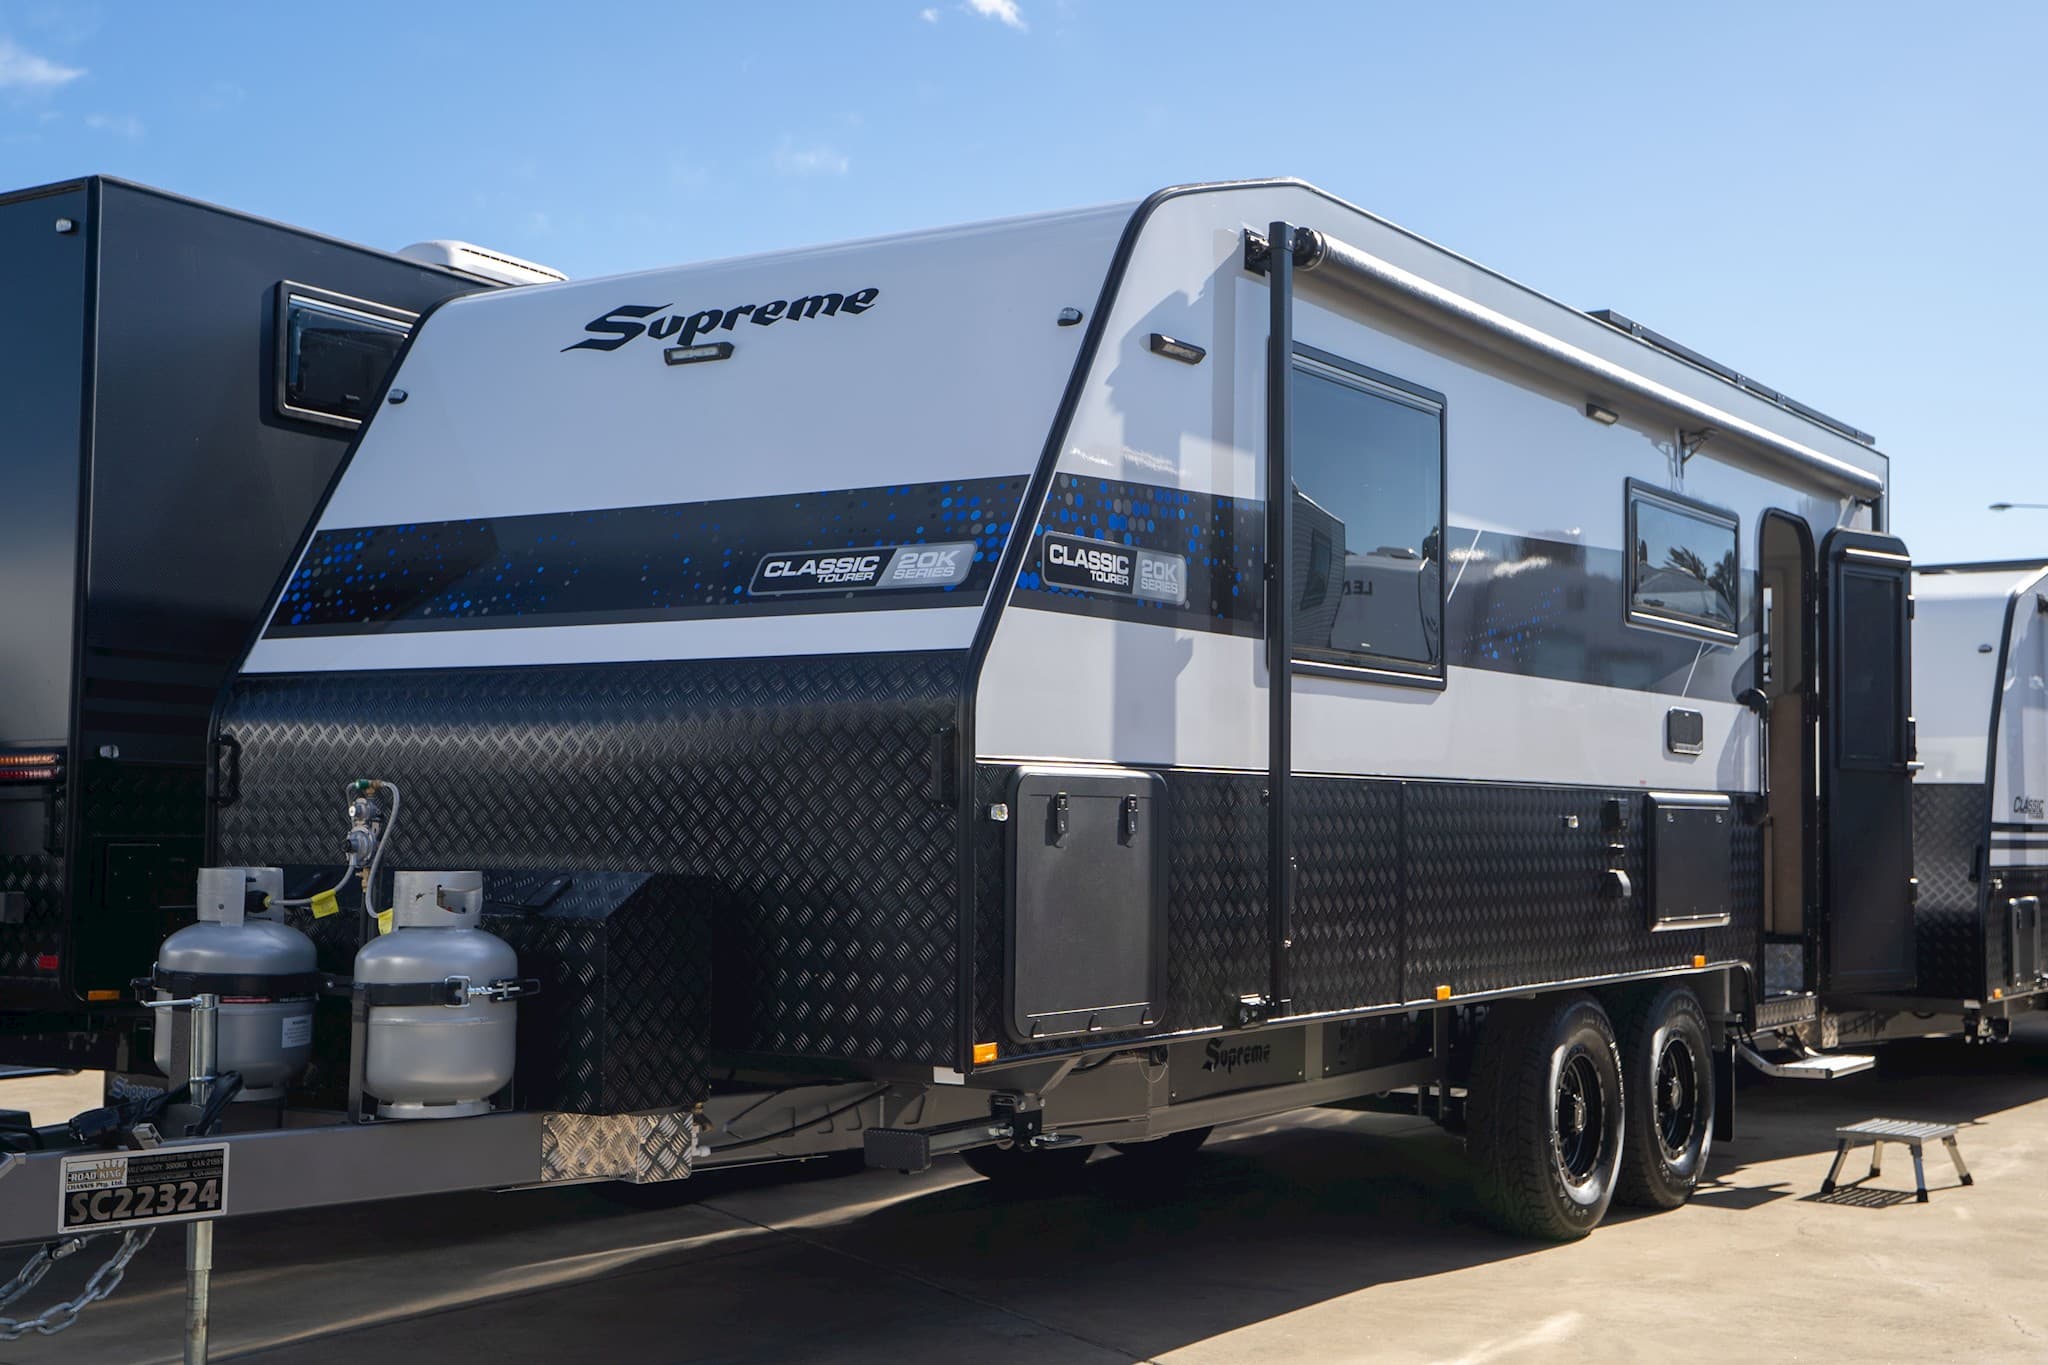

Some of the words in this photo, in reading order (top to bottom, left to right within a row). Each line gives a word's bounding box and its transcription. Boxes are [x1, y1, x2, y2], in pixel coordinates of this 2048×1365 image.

[560, 288, 880, 352] Supreme
[763, 555, 881, 578] CLASSIC
[898, 550, 961, 569] 20K
[1049, 543, 1129, 575] CLASSIC
[817, 571, 875, 584] TOURER
[892, 566, 956, 580] SERIES
[1089, 570, 1129, 586] TOURER
[1141, 559, 1177, 582] 20K
[1140, 577, 1178, 595] SERIES
[1201, 1037, 1272, 1075] Supreme
[70, 1171, 97, 1182] ROAD
[99, 1169, 122, 1180] KING
[69, 1178, 220, 1224] SC22324
